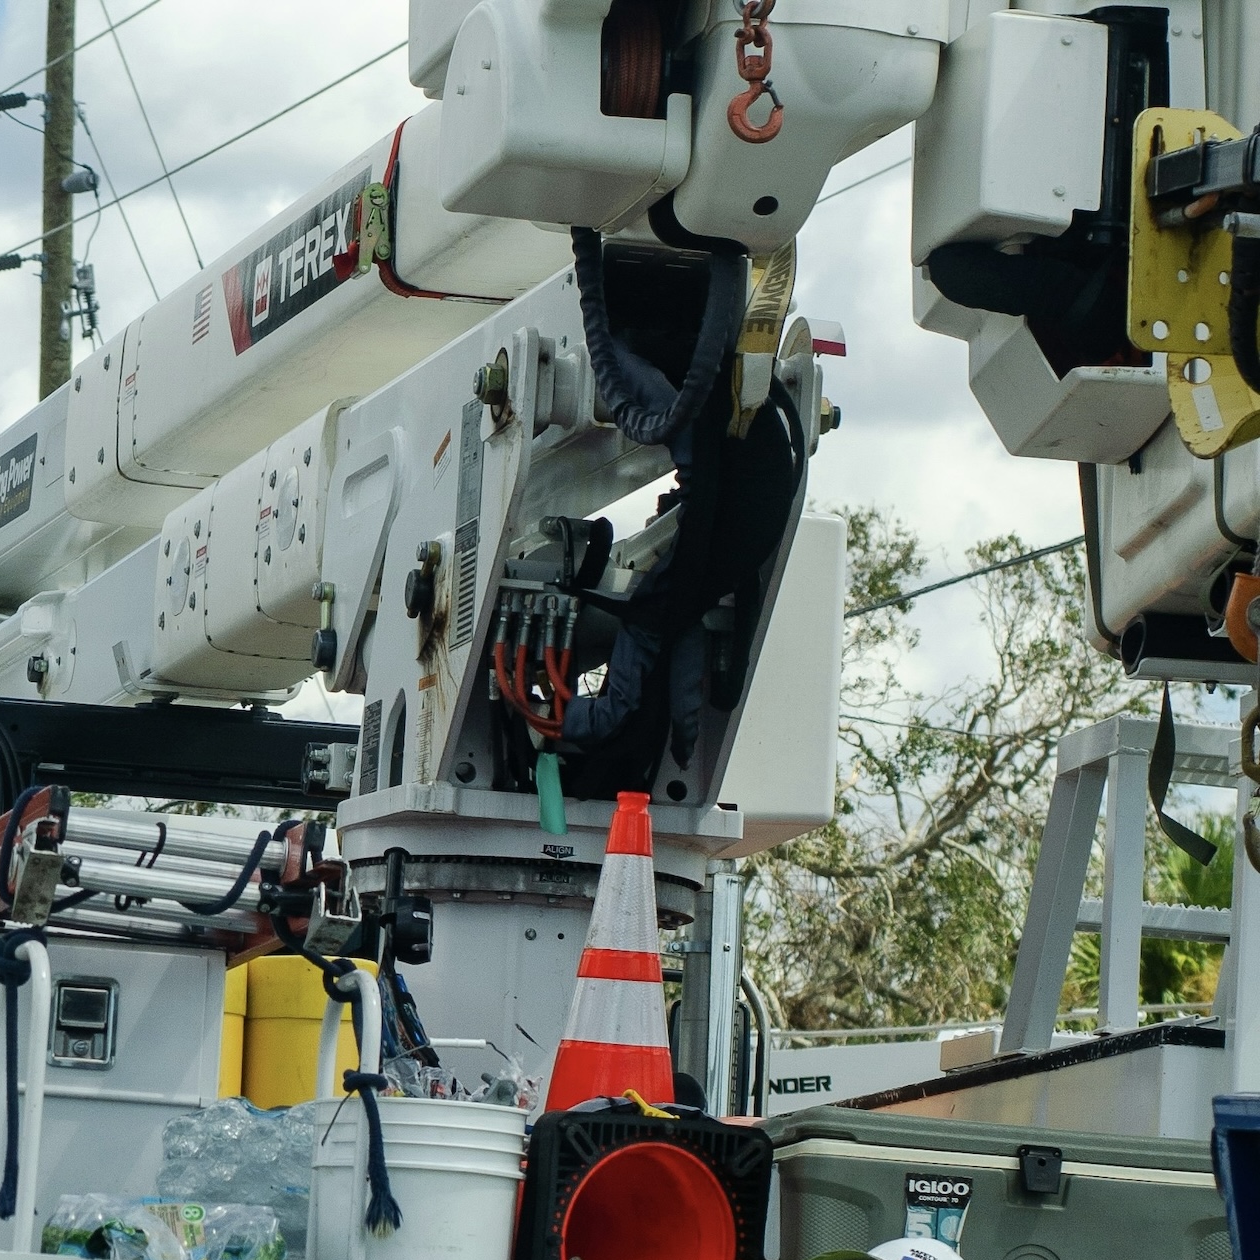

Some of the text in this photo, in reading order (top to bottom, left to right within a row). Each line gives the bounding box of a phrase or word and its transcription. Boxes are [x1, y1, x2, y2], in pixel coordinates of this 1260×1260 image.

[278, 201, 352, 304] TEREX
[7, 452, 35, 493] Power
[545, 845, 572, 855] ALIGN
[752, 1075, 832, 1096] NDER
[908, 1179, 970, 1196] IGLOO
[910, 1248, 938, 1260] SAFETY
